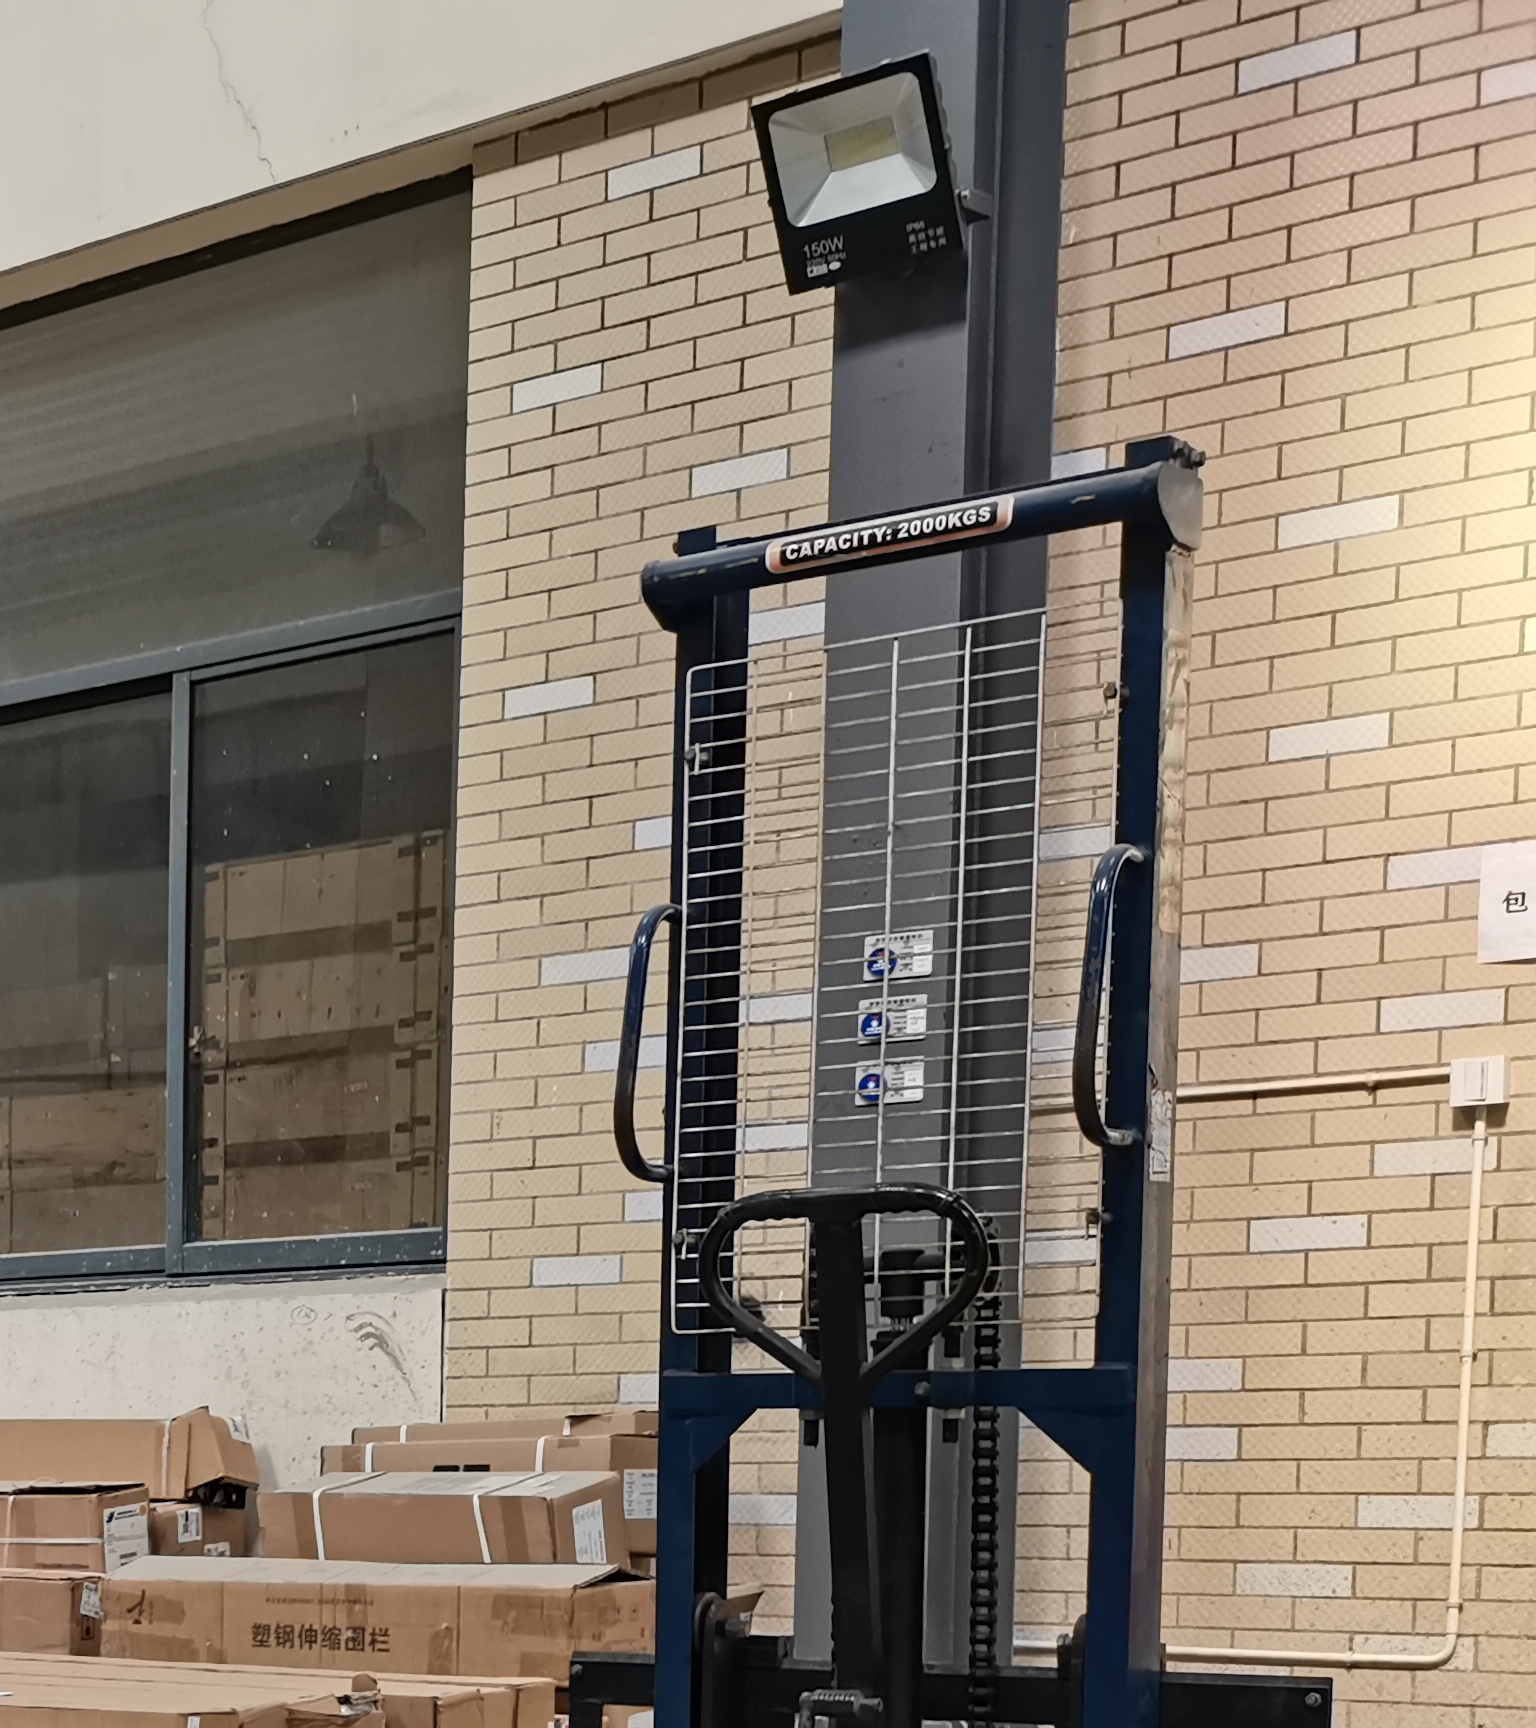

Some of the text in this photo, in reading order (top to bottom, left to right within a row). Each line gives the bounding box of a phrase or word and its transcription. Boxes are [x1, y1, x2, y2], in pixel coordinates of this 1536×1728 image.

[803, 235, 844, 259] 150W
[785, 506, 992, 560] CAPACITY: 2000KGS
[1502, 890, 1528, 914] 包
[251, 1622, 391, 1653] 塑钢伸缩围栏
